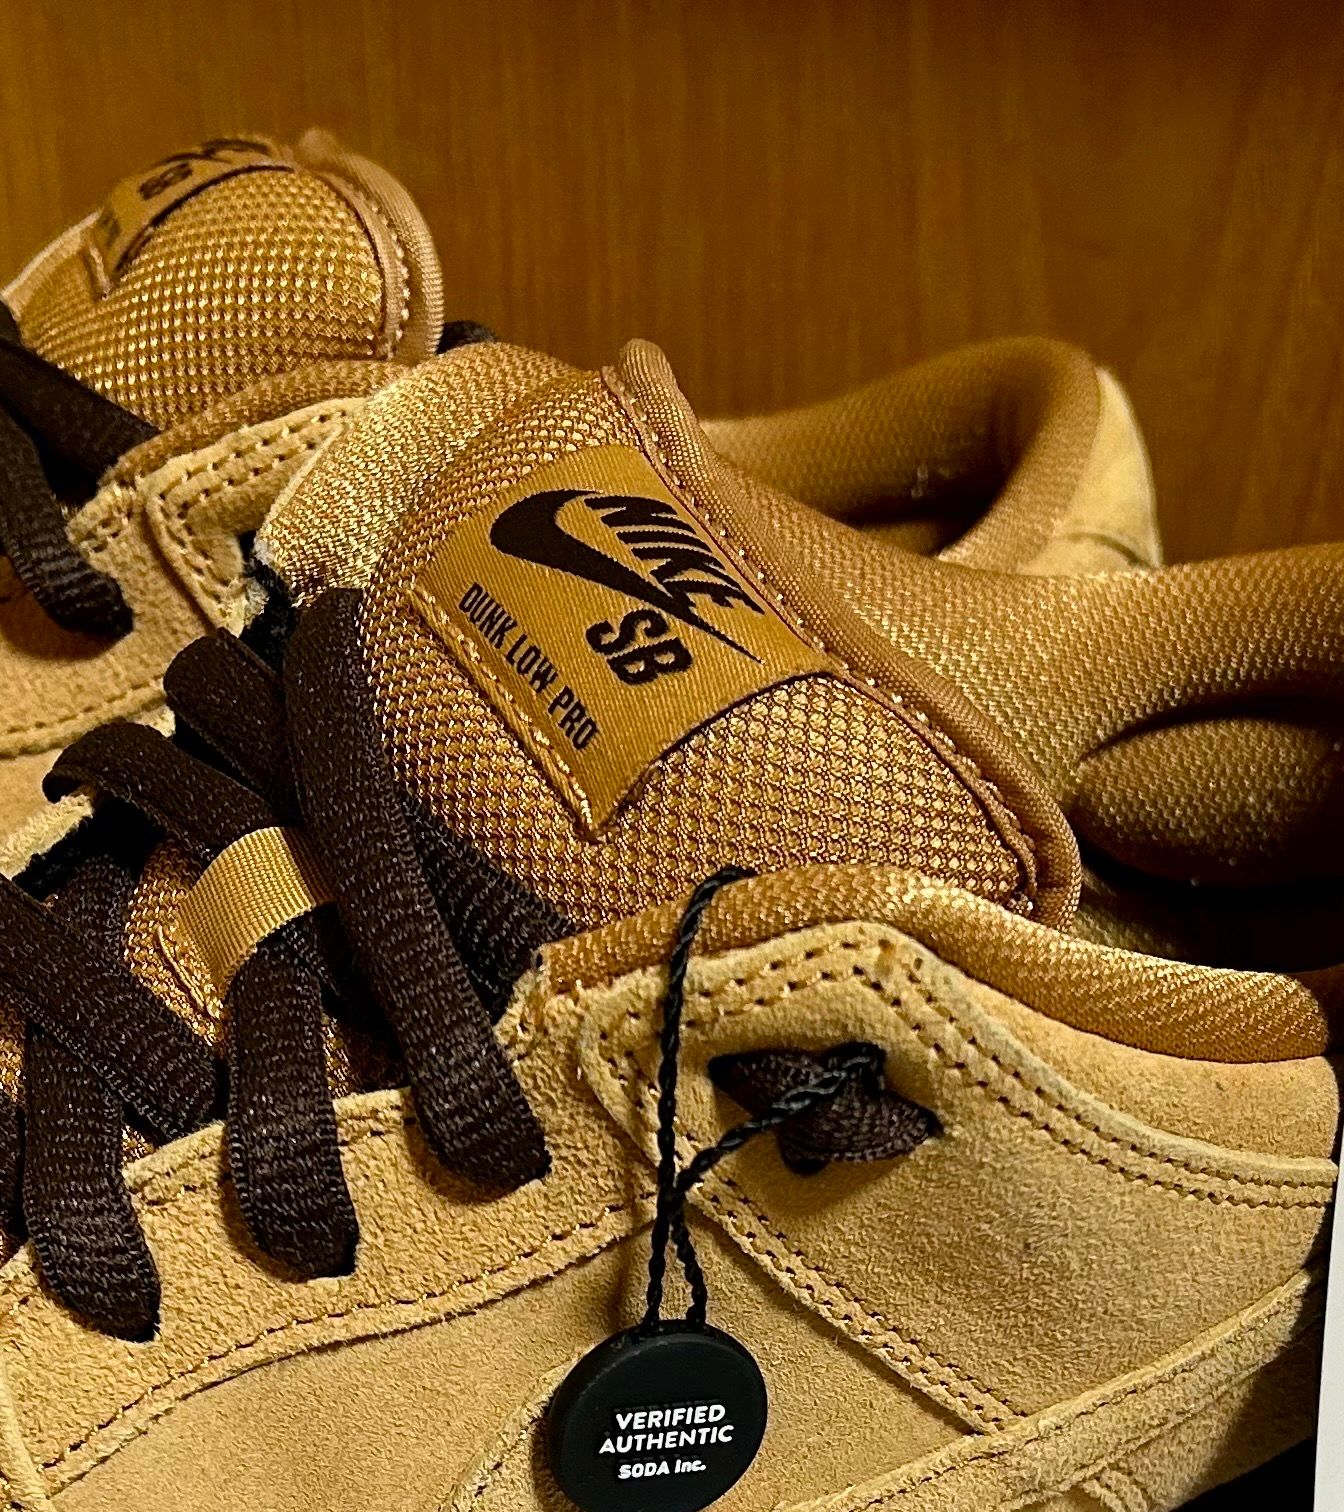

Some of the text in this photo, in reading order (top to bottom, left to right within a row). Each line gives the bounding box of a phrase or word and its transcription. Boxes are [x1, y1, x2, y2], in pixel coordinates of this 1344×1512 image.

[583, 494, 766, 622] NIKE
[458, 582, 599, 751] DUNK LOW PRO
[585, 608, 693, 686] SB
[598, 1424, 735, 1455] AUTHENTIC
[615, 1404, 726, 1430] VERIFIED
[617, 1458, 707, 1480] SODA Inc.
